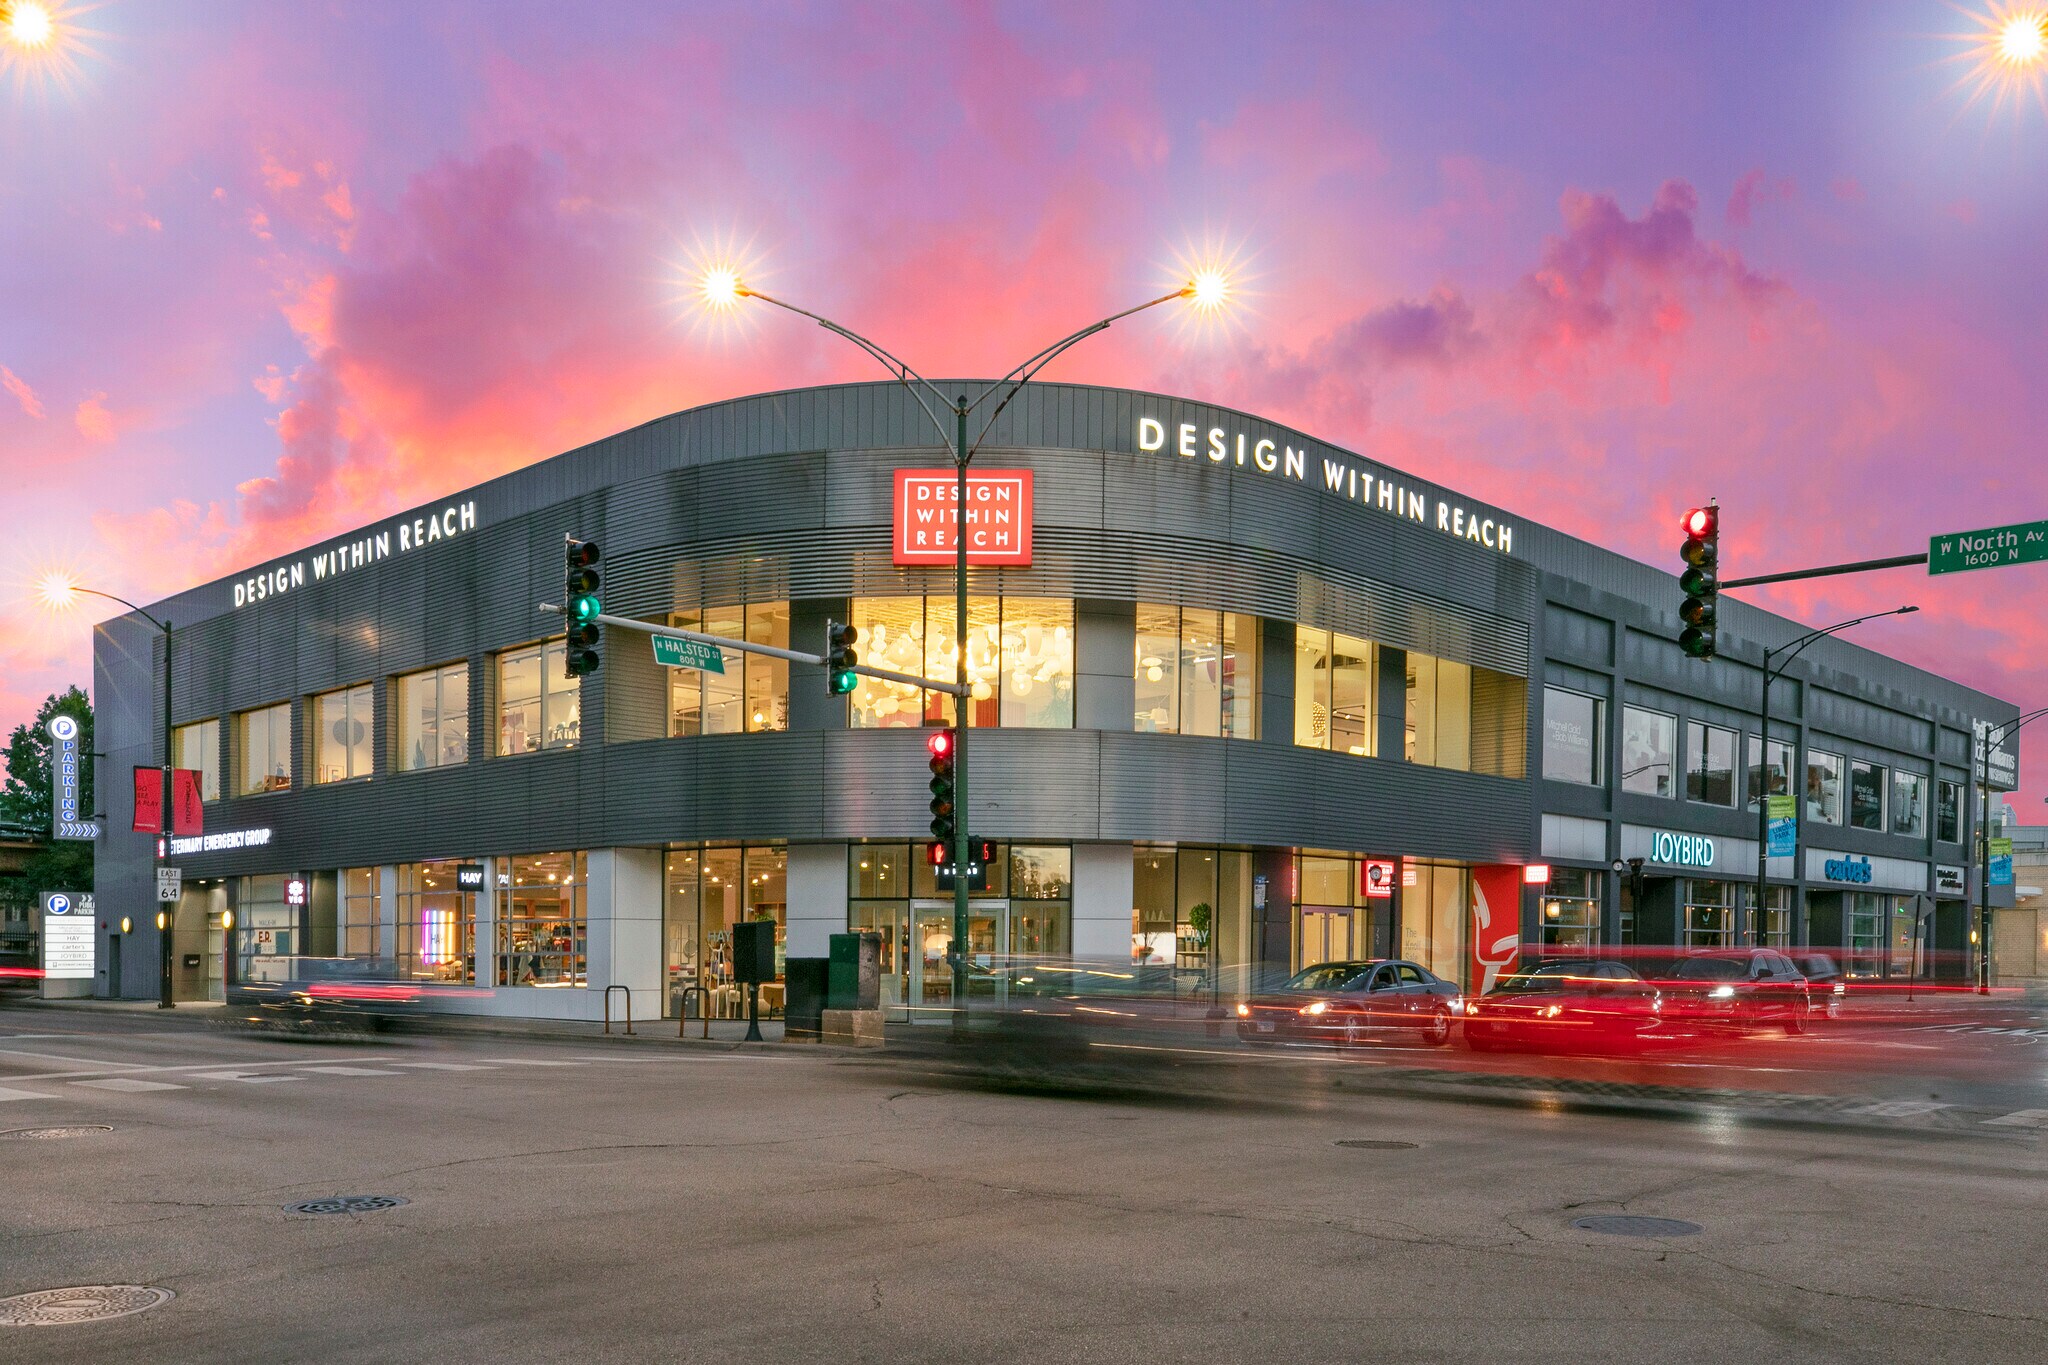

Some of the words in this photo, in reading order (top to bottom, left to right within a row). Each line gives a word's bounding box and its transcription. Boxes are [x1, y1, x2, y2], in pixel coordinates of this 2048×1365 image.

[917, 486, 1010, 501] DESIGN
[1140, 418, 1304, 480] DESIGN
[1323, 459, 1424, 523] WITHIN
[1438, 502, 1511, 554] REACH
[916, 509, 1009, 523] WITHIN
[1941, 542, 1951, 554] W
[1958, 531, 2018, 553] North
[234, 562, 303, 607] DESIGN
[312, 531, 390, 580] WITHIN
[400, 501, 475, 551] REACH
[1965, 551, 1999, 565] 1600
[2008, 548, 2018, 560] N
[657, 641, 663, 649] N
[665, 640, 711, 658] HALSTED
[680, 655, 696, 665] 800
[699, 659, 705, 667] W
[61, 740, 76, 821] PARKING
[1772, 822, 1797, 834] LINCOLN
[204, 831, 245, 851] EMERGENCY
[245, 828, 270, 846] GROUP
[1774, 831, 1790, 841] PARK
[1651, 832, 1714, 867] JOYBIRD
[1824, 854, 1872, 884] carter's
[460, 872, 482, 884] HAY
[161, 888, 178, 899] 64
[708, 930, 732, 942] HAY
[1184, 929, 1209, 943] HAY
[1405, 927, 1417, 938] The
